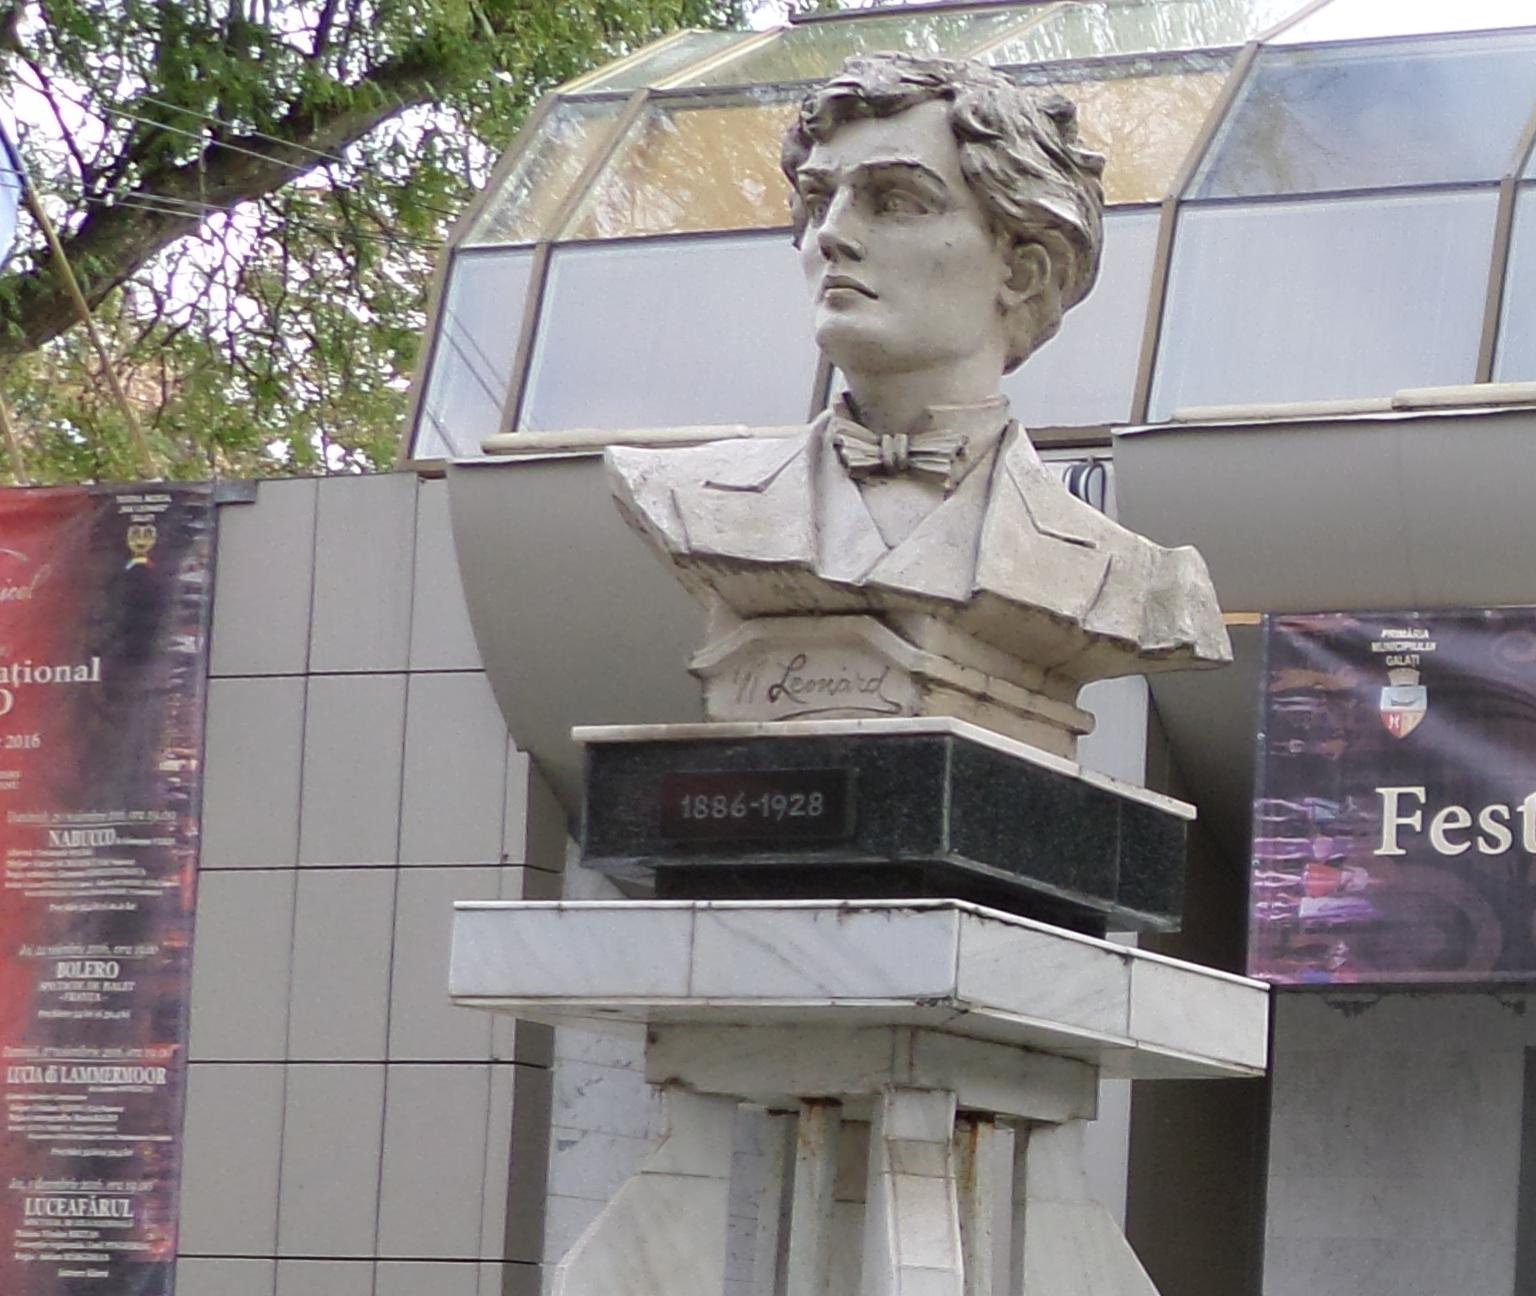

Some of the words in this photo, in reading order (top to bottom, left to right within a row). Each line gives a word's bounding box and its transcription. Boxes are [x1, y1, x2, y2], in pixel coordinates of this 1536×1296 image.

[768, 653, 894, 706] Leonard
[681, 791, 824, 821] 1886-1928
[57, 961, 119, 979] BOLERO
[60, 1066, 167, 1084] LAMMERMOOR
